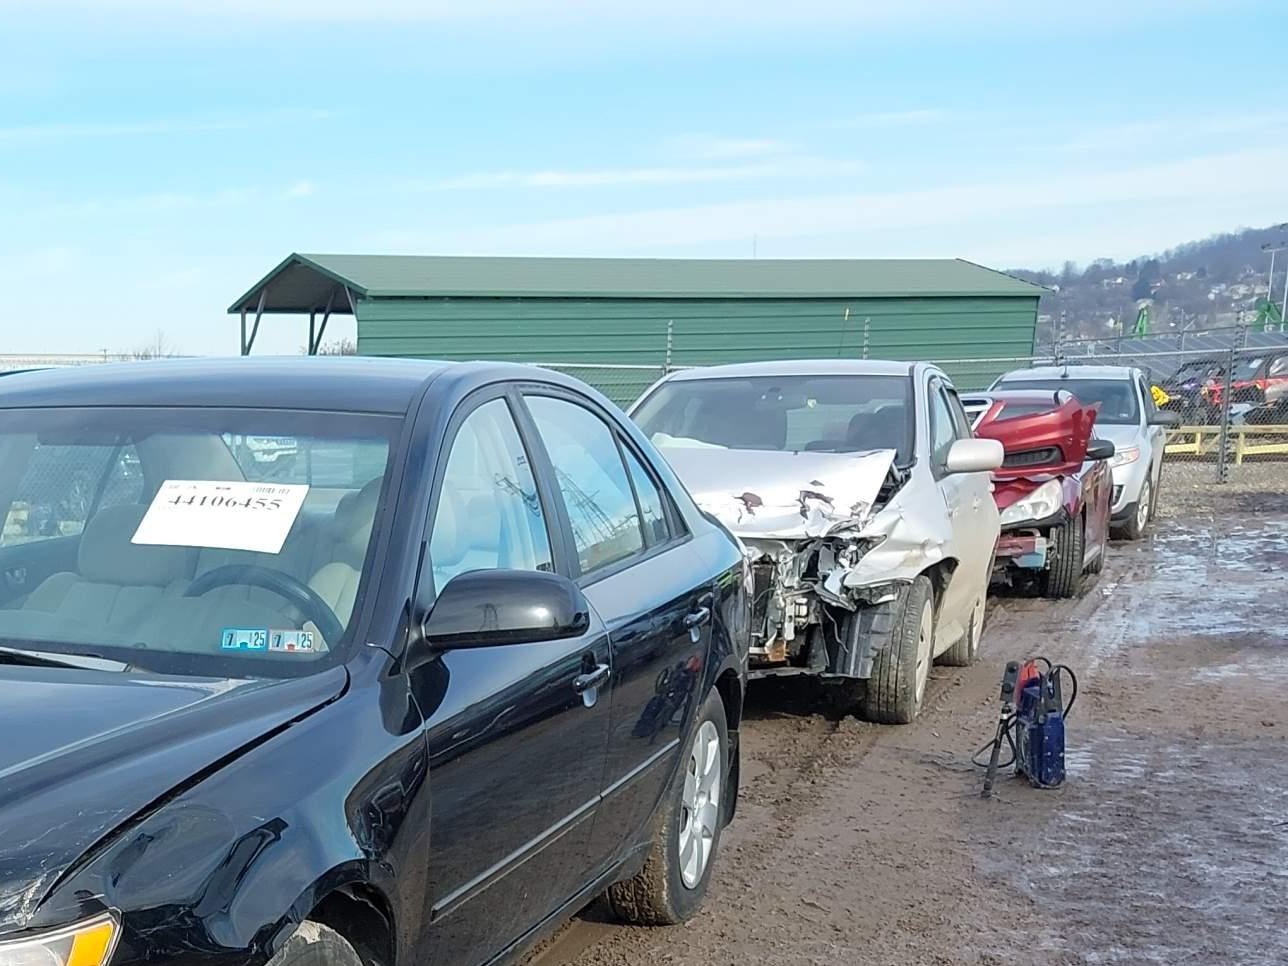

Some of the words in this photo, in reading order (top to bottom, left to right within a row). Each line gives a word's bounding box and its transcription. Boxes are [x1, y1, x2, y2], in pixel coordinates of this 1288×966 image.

[168, 495, 283, 511] 44106455
[253, 632, 265, 647] 25
[301, 634, 312, 649] 25
